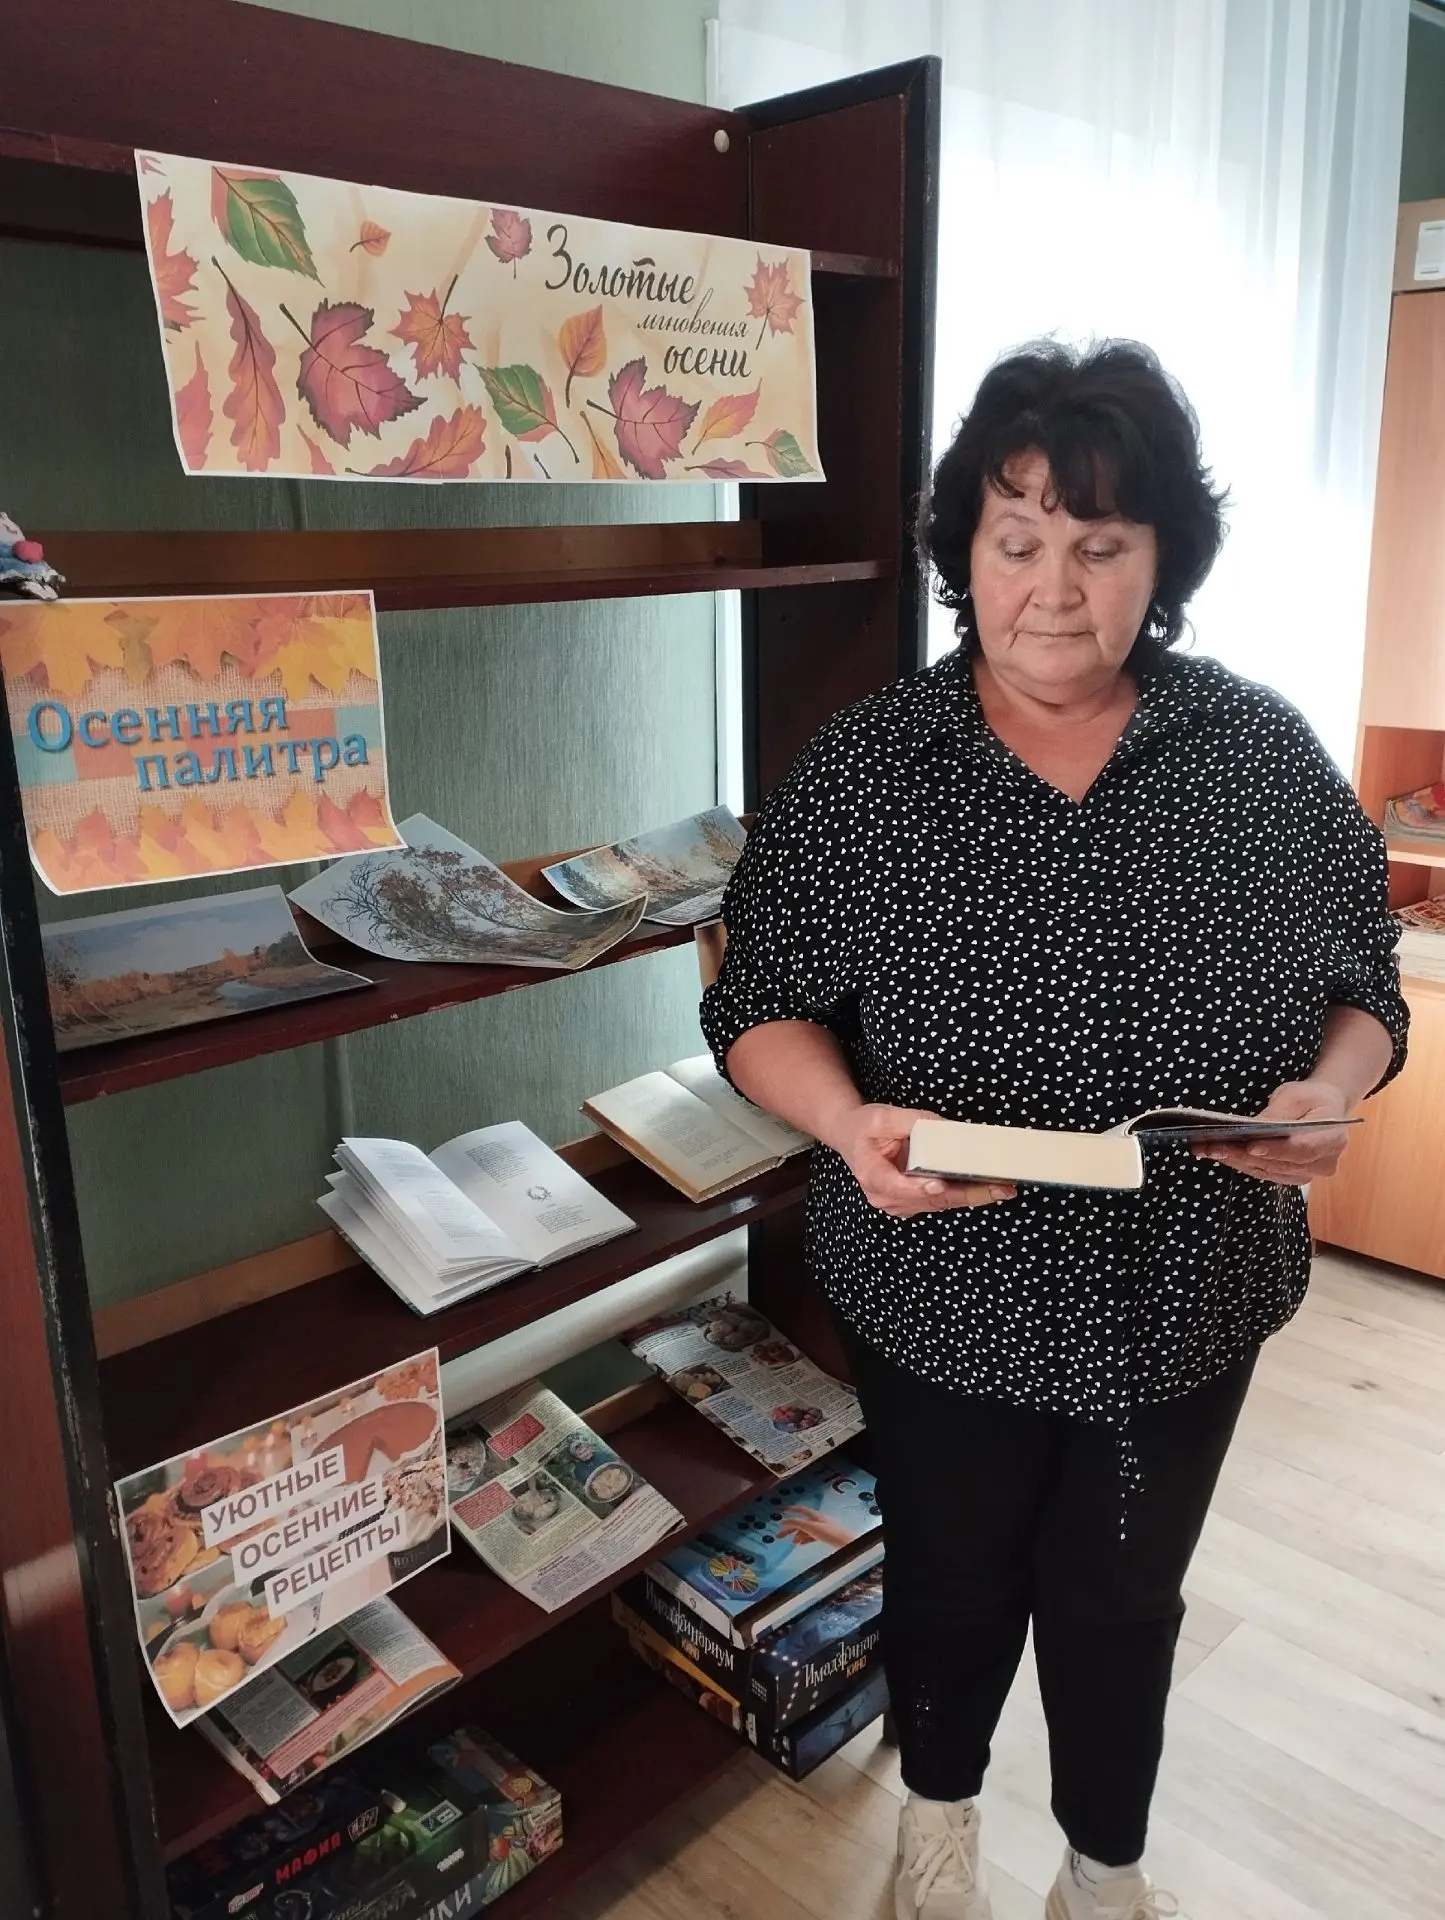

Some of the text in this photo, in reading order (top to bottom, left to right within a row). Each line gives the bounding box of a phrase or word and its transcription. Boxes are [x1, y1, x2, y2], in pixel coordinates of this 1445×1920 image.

[545, 224, 695, 304] Золотые
[637, 287, 750, 341] мгновения
[663, 345, 752, 378] осени
[28, 696, 288, 753] Осенняя
[135, 732, 370, 791] палитра
[207, 1453, 340, 1534] УЮТНЫЕ
[240, 1481, 379, 1570] ОСЕННИЕ
[272, 1516, 401, 1605] РЕЦЕПТЫ
